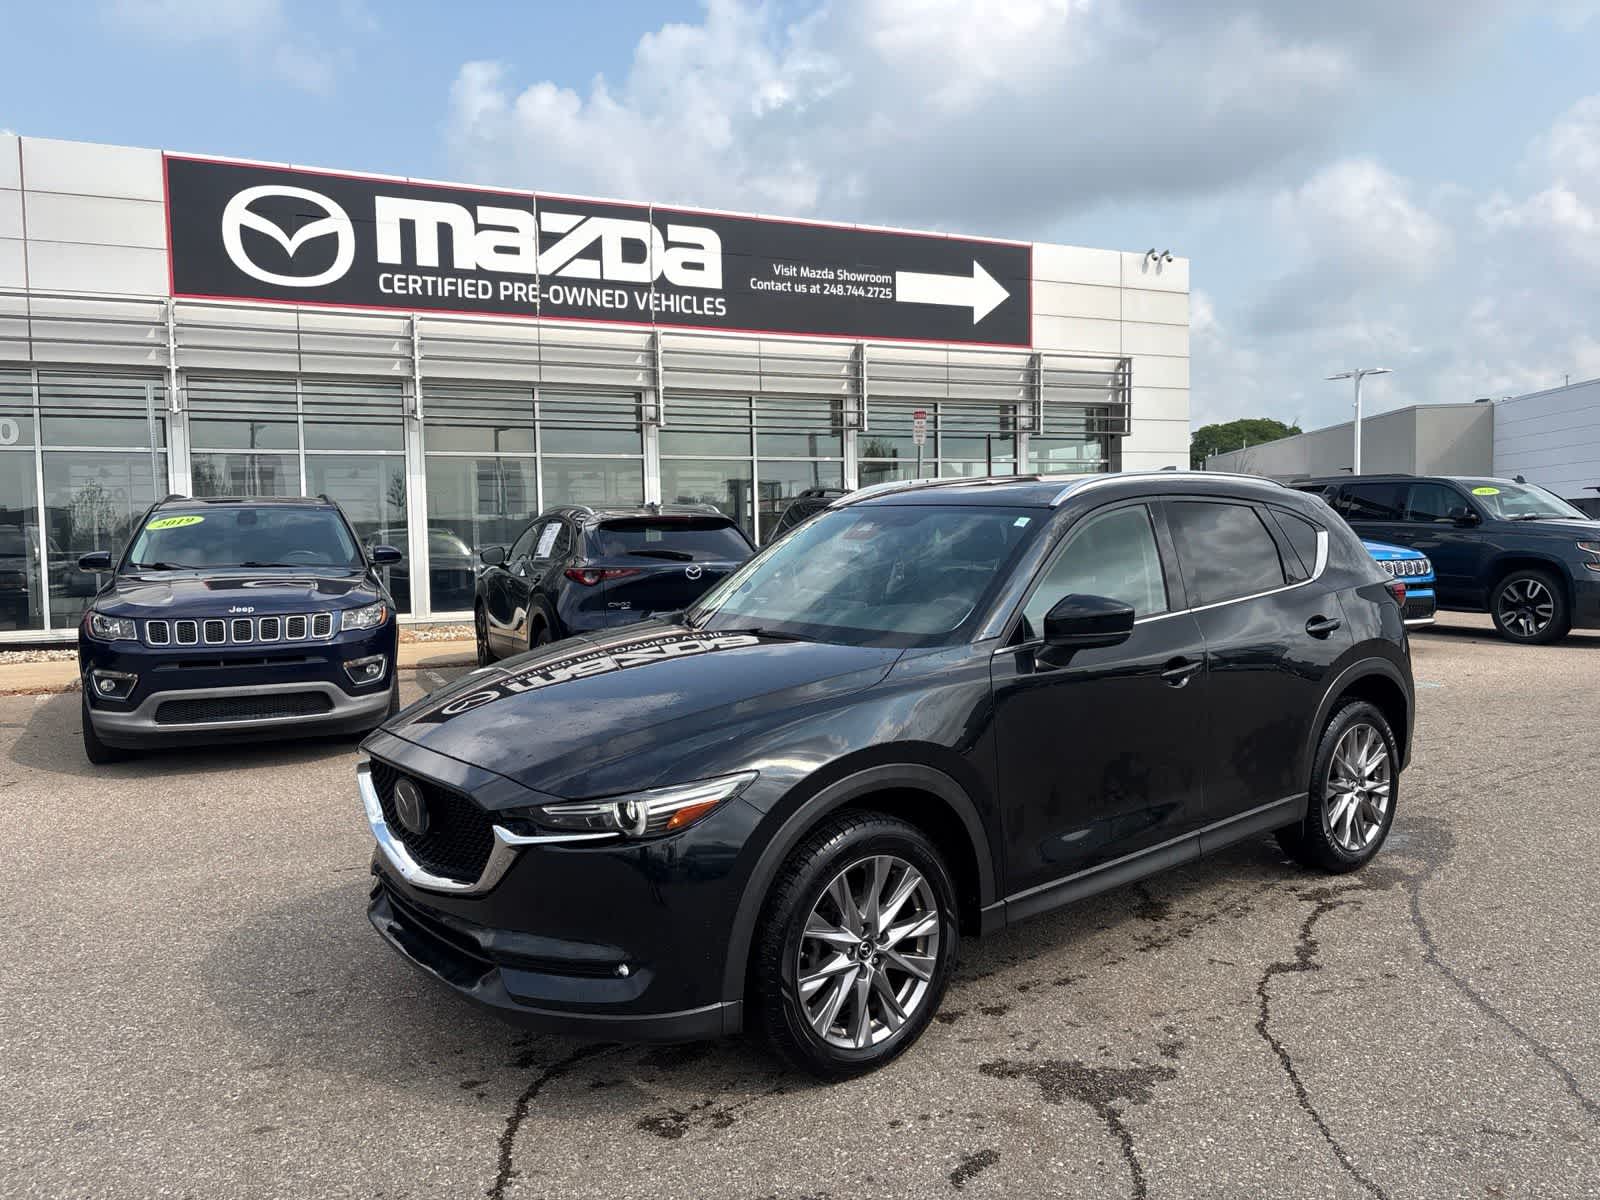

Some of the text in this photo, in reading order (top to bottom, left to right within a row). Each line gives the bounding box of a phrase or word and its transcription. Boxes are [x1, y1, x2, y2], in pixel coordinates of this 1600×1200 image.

[773, 264, 892, 284] Visit Mazda Showroom
[378, 272, 727, 316] CERTIFIED PRE-OWNED VEHICLES
[750, 278, 893, 299] Contact us at 248.744.2725
[228, 605, 255, 613] Jeep
